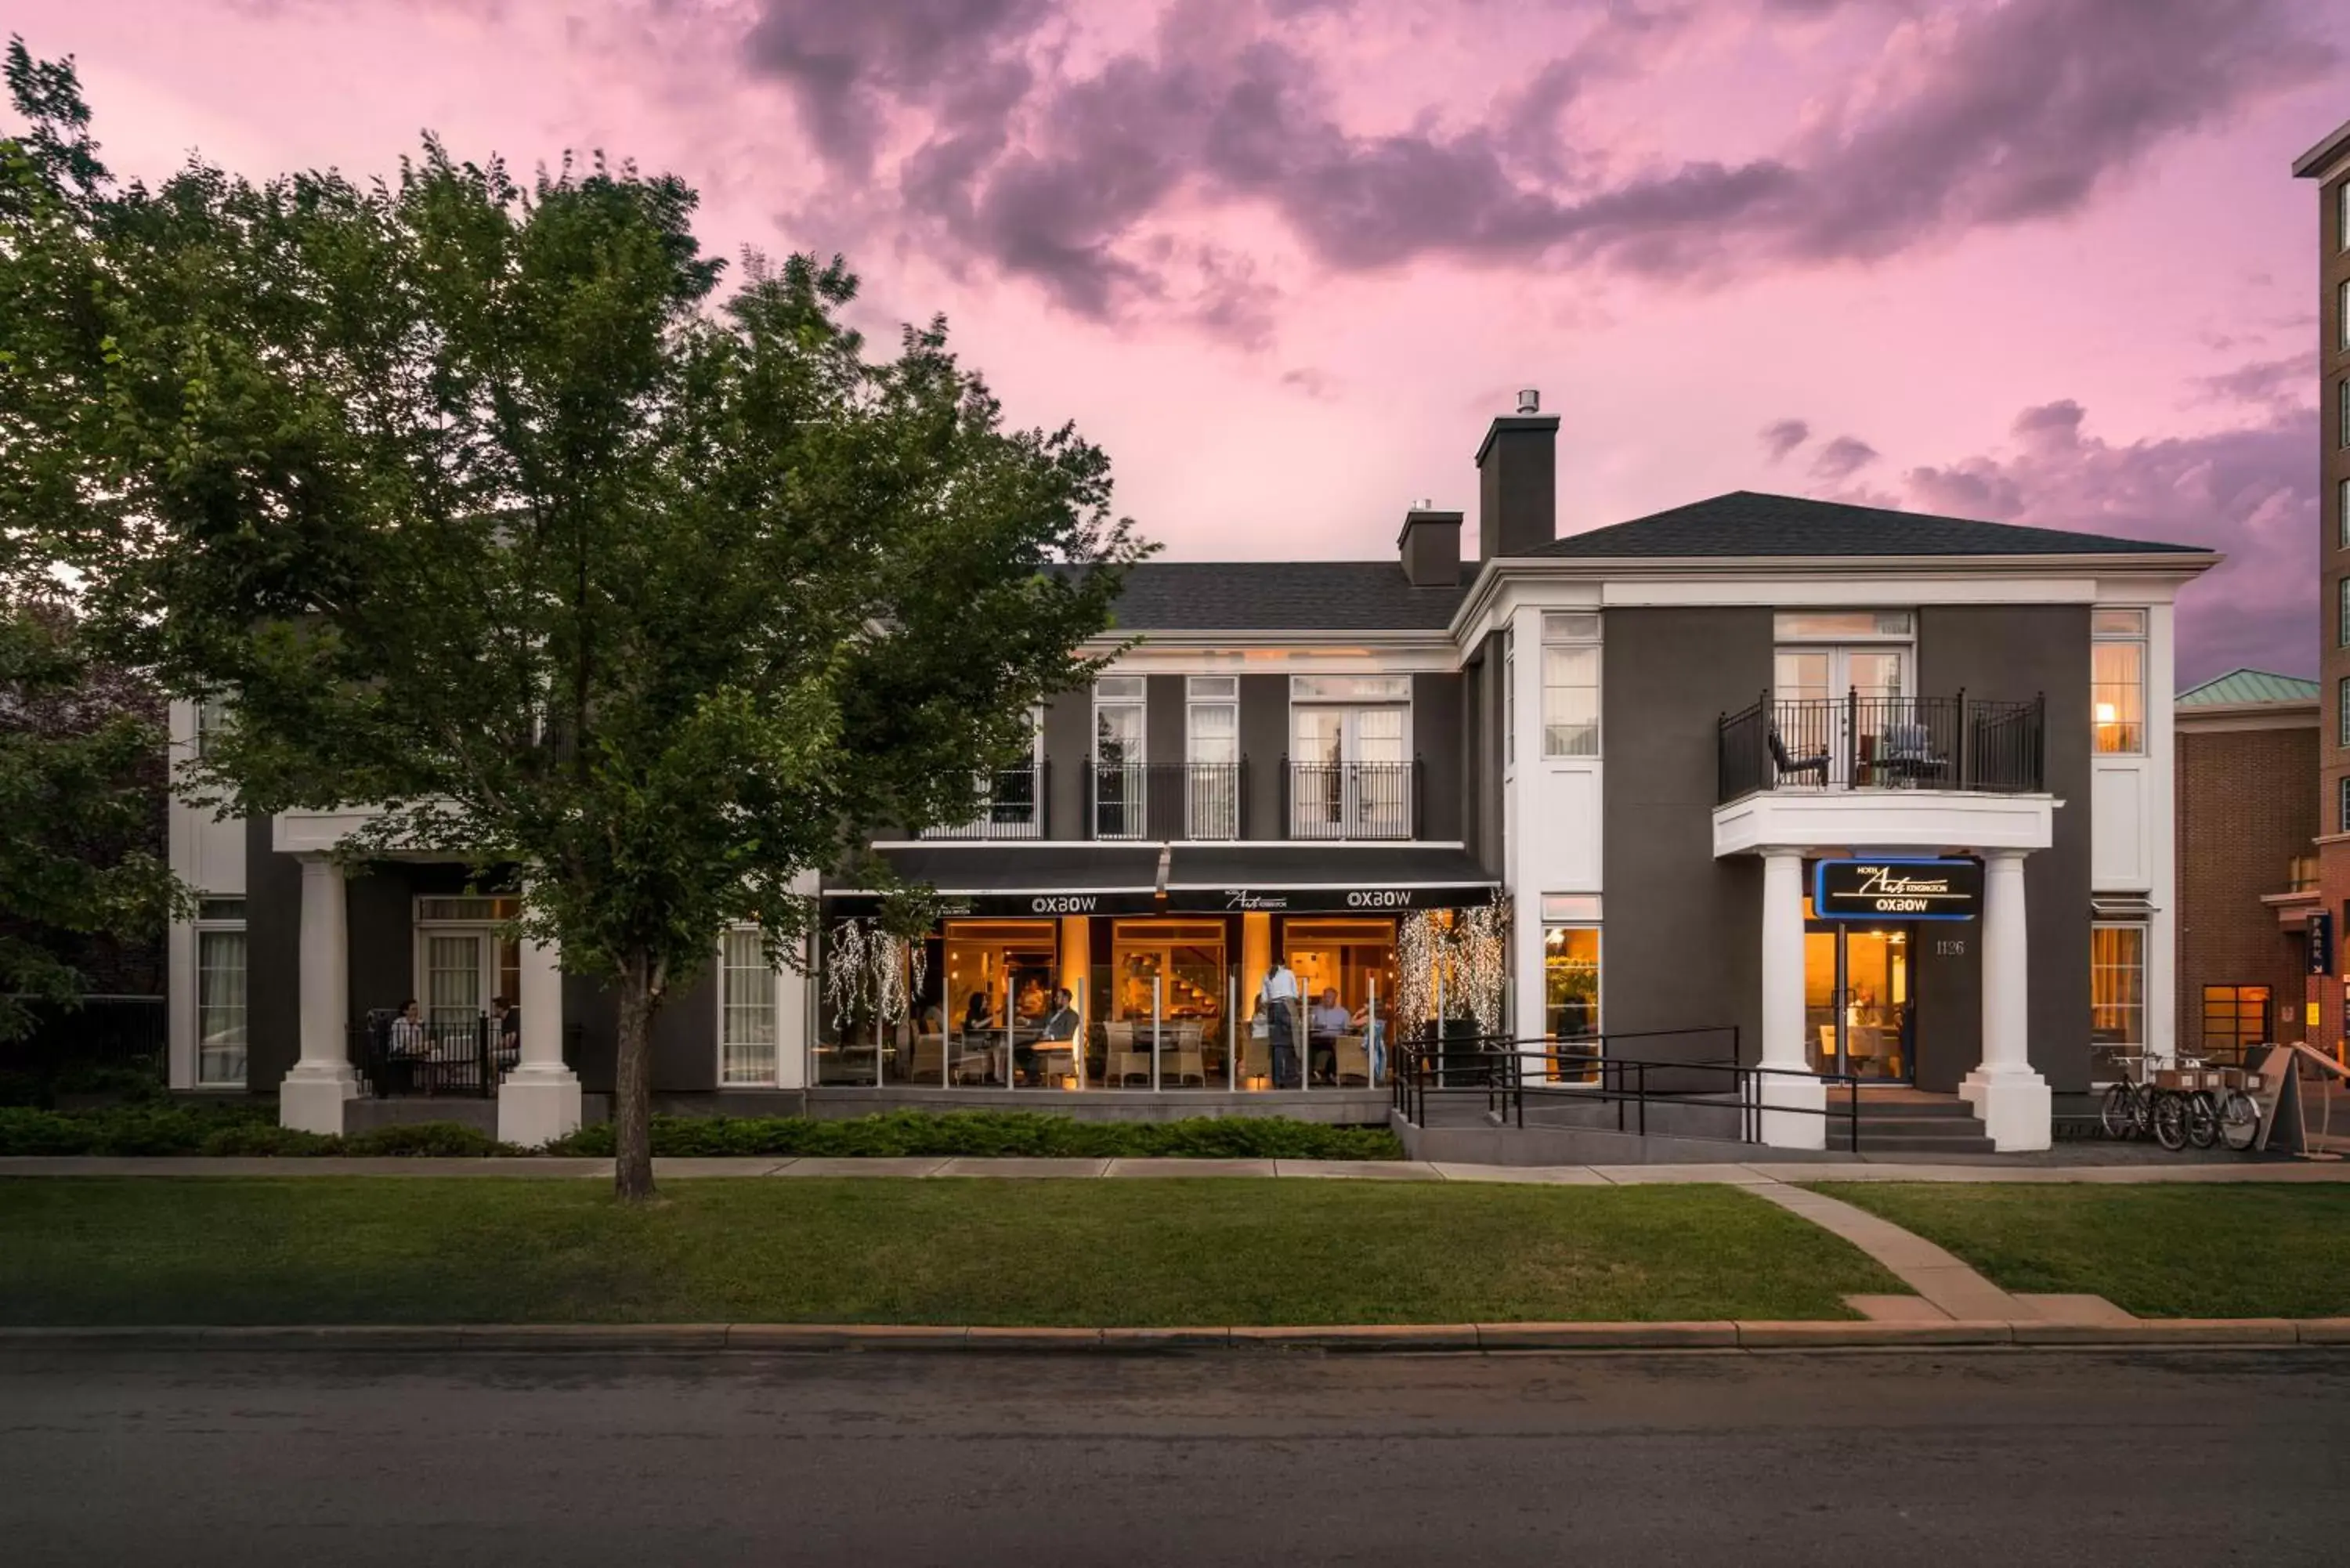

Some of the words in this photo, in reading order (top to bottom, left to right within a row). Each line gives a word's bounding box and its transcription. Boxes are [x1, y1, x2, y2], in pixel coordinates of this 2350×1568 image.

[1859, 865, 1911, 894] Arts
[1032, 896, 1096, 912] OXBOW
[1347, 891, 1411, 906] OXBOW
[1876, 898, 1928, 912] OXBOW
[2312, 917, 2323, 959] PARK
[1936, 940, 1964, 955] 1126
